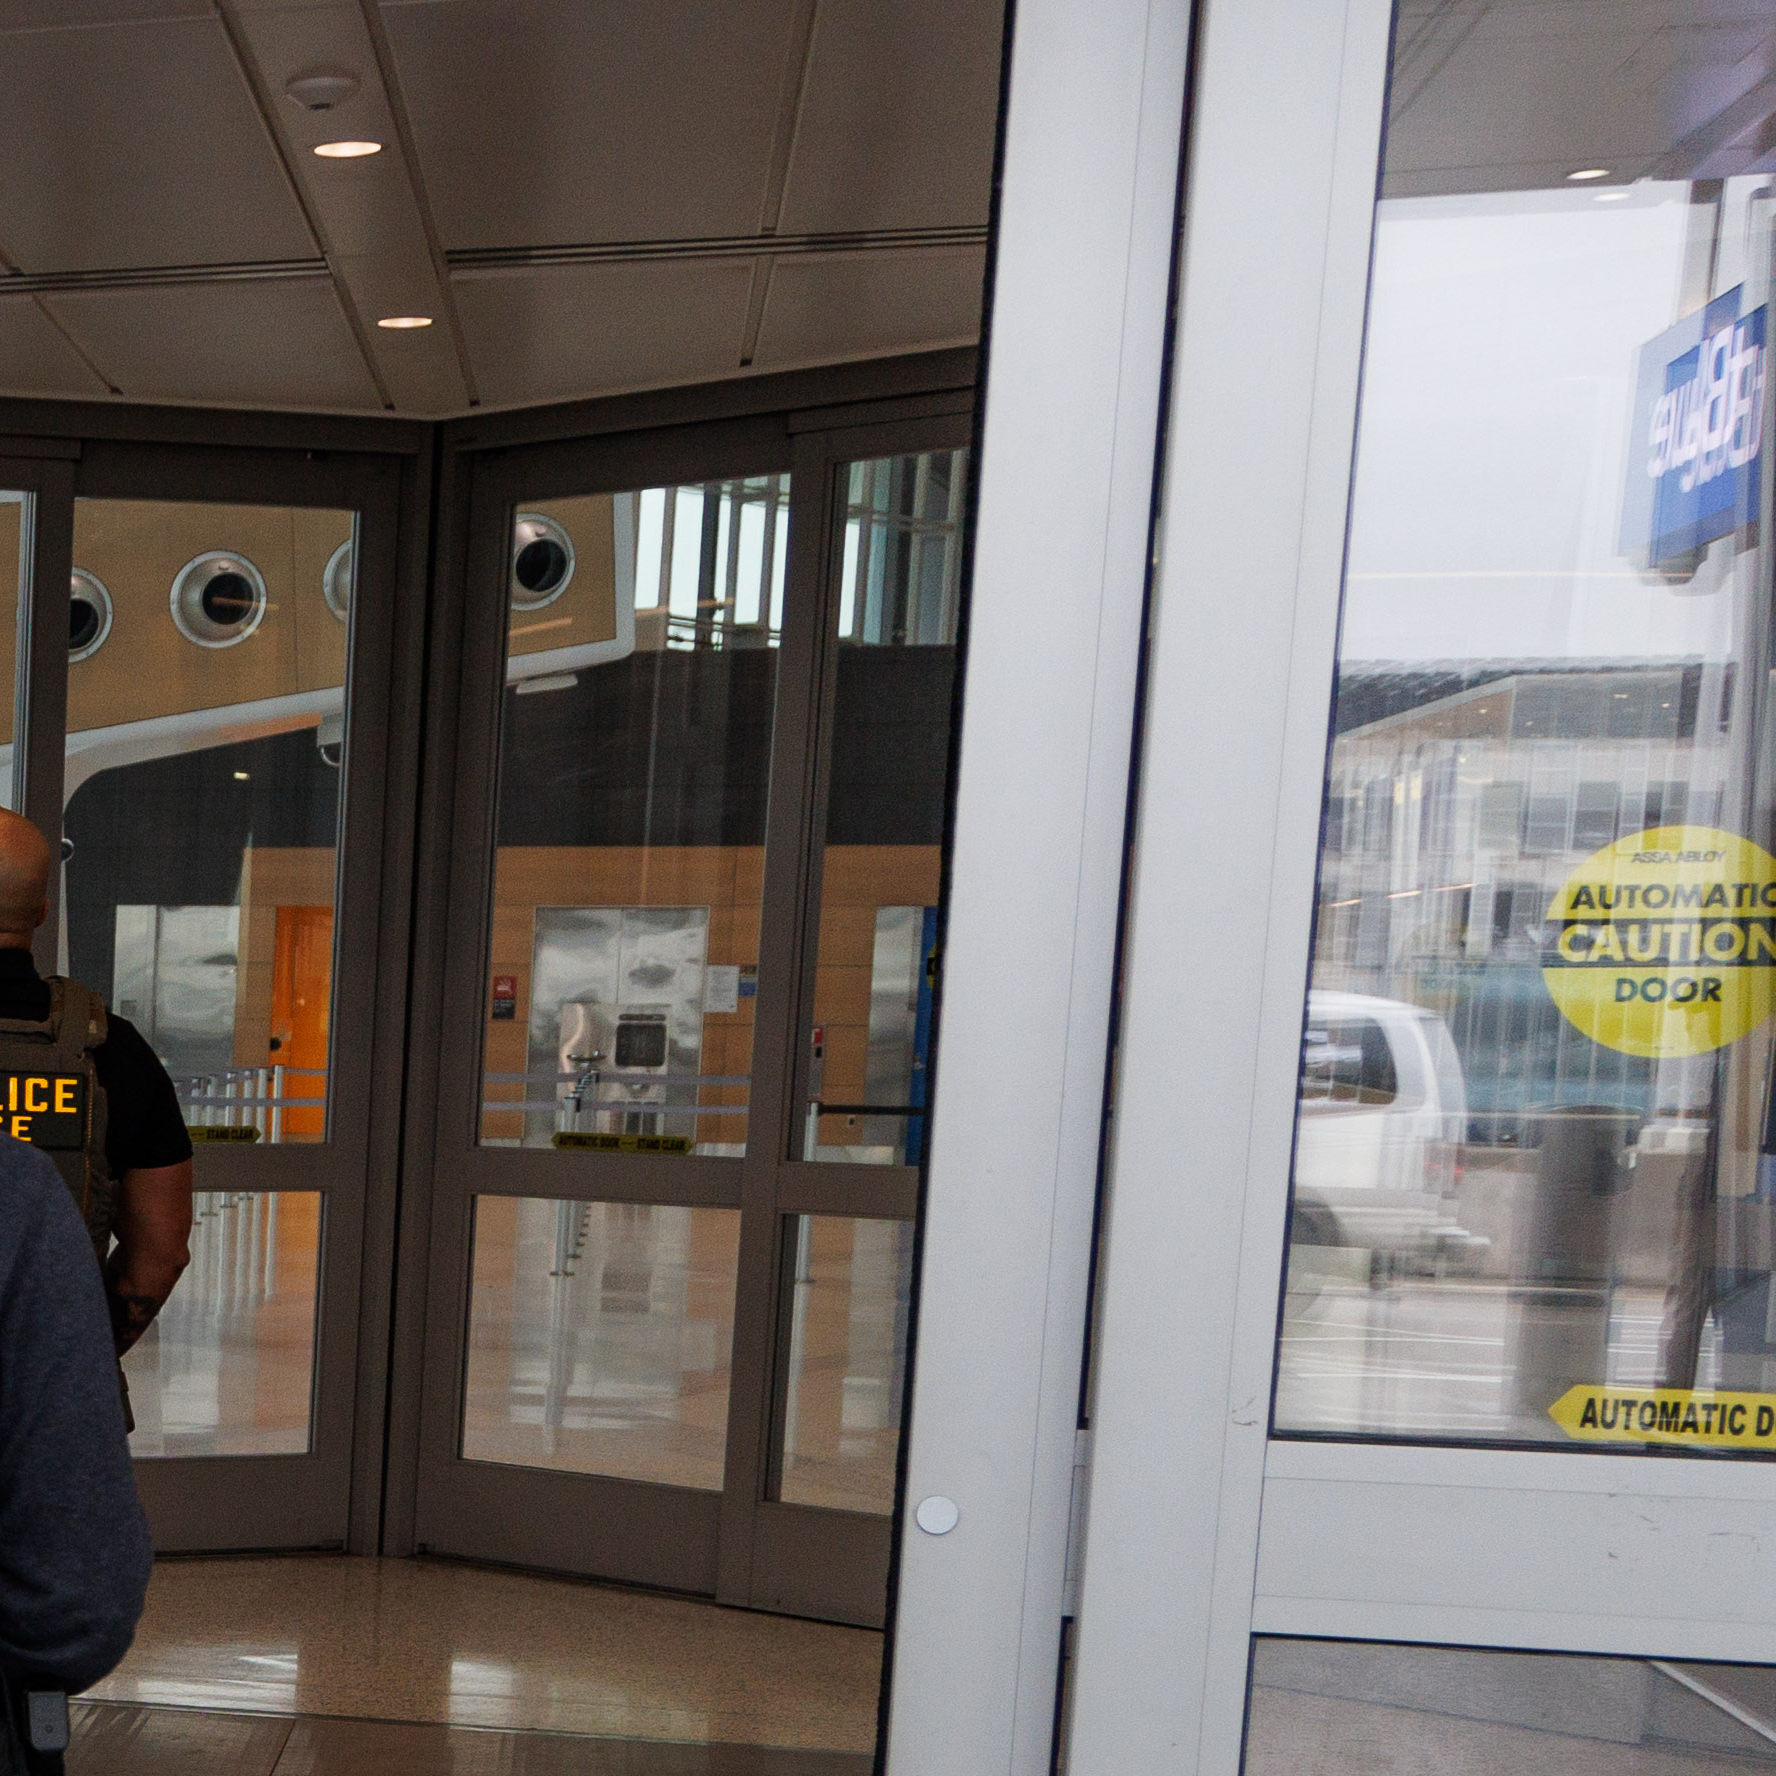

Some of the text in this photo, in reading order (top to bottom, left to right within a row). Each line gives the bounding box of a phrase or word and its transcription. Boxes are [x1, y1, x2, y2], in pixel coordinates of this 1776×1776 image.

[1632, 852, 1672, 863] ASSA
[1558, 922, 1776, 962] CAUTION
[1615, 977, 1721, 1002] DOOR
[1579, 1398, 1747, 1436] AUTOMATIC
